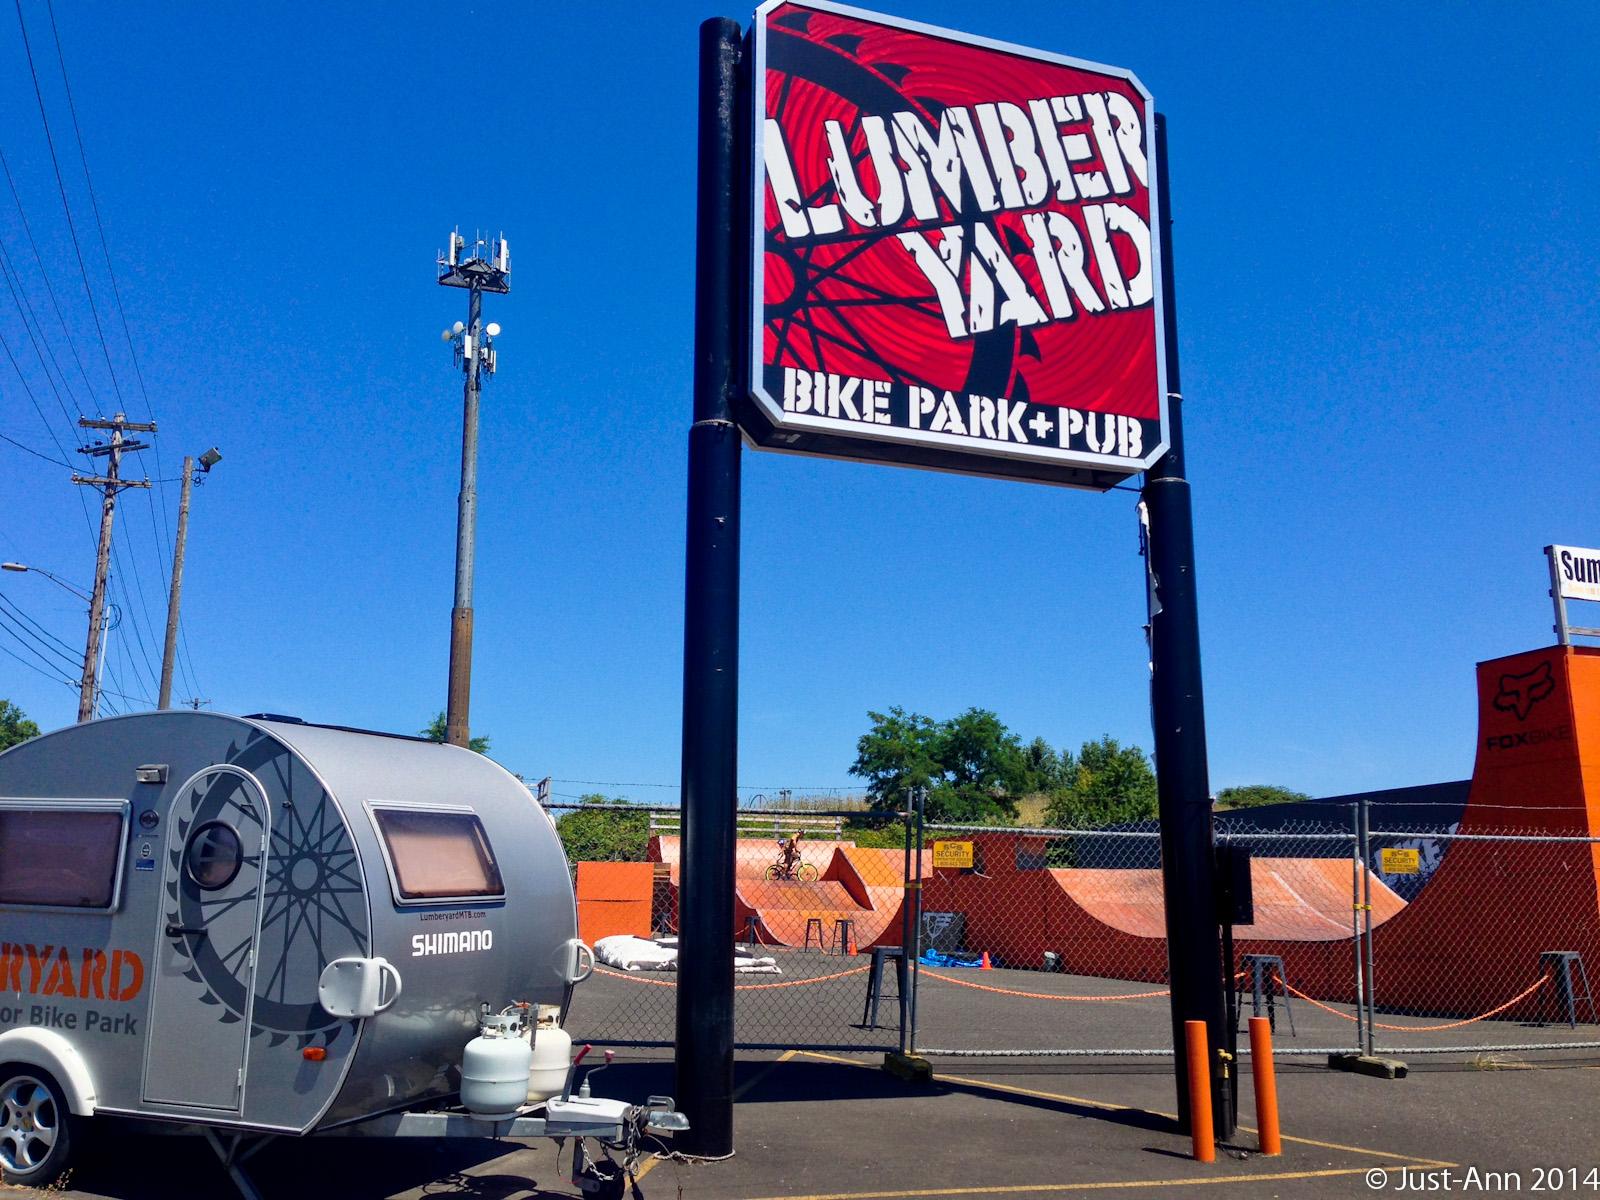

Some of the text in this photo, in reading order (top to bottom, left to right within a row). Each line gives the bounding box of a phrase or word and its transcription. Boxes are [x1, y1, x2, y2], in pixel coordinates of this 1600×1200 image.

[764, 92, 1149, 238] LUMBER
[897, 203, 1153, 338] YARD
[783, 367, 892, 424] BIKE
[0, 942, 145, 1002] RYARD
[411, 929, 493, 957] SHIMANO
[30, 1005, 77, 1030] Bike
[85, 1010, 138, 1036] Park
